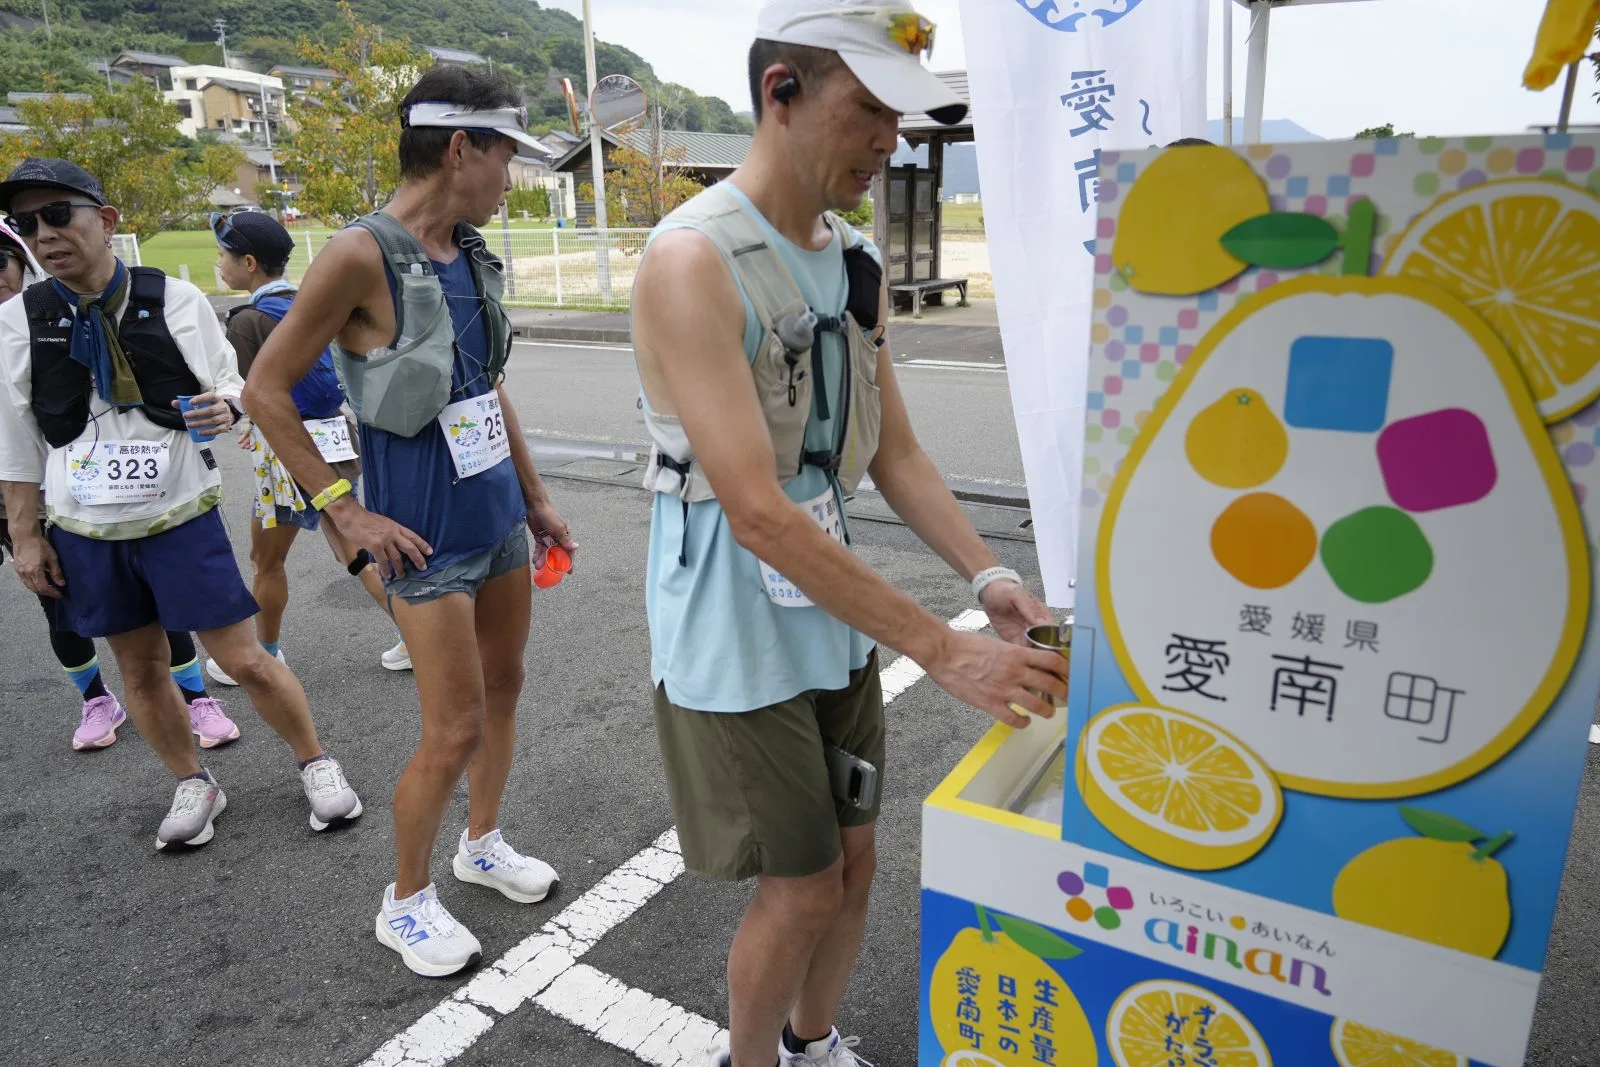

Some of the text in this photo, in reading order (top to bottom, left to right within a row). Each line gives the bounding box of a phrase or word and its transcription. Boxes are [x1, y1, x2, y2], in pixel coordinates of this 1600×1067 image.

[107, 459, 159, 480] 323
[120, 445, 162, 455] 高砂熱学
[331, 429, 350, 445] 34
[1239, 604, 1380, 653] 愛媛県
[1161, 633, 1467, 744] 愛南町
[1144, 917, 1333, 997] ainan
[1150, 892, 1337, 958] いろこい あいなん
[955, 966, 985, 1050] 愛南町
[996, 973, 1021, 1054] 日本一の
[1028, 978, 1060, 1067] 生産量
